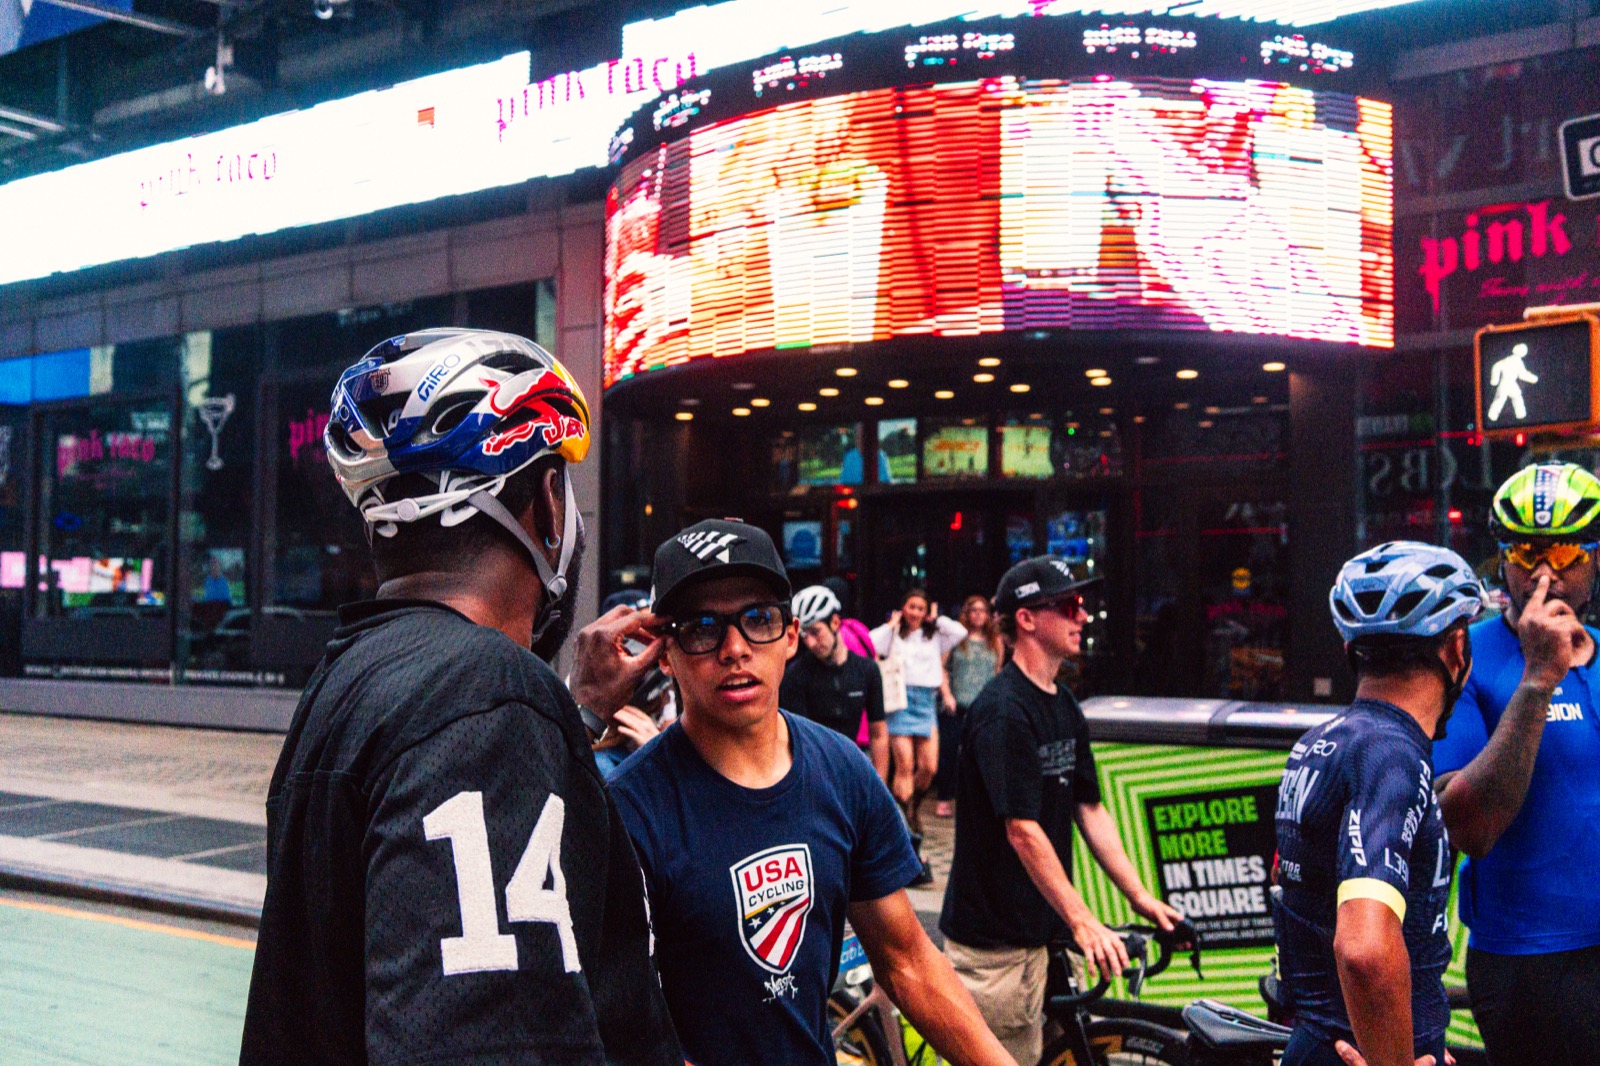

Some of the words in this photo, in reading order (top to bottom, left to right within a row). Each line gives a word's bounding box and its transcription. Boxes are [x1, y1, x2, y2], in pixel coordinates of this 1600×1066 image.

[1419, 200, 1572, 316] pink
[1153, 795, 1258, 831] EXPLORE
[1158, 828, 1228, 860] MORE
[422, 791, 582, 976] 14
[744, 856, 803, 892] USA
[1163, 861, 1192, 890] IN
[1192, 855, 1267, 887] TIMES
[748, 879, 805, 908] CYCLING
[1168, 885, 1267, 918] SQUARE
